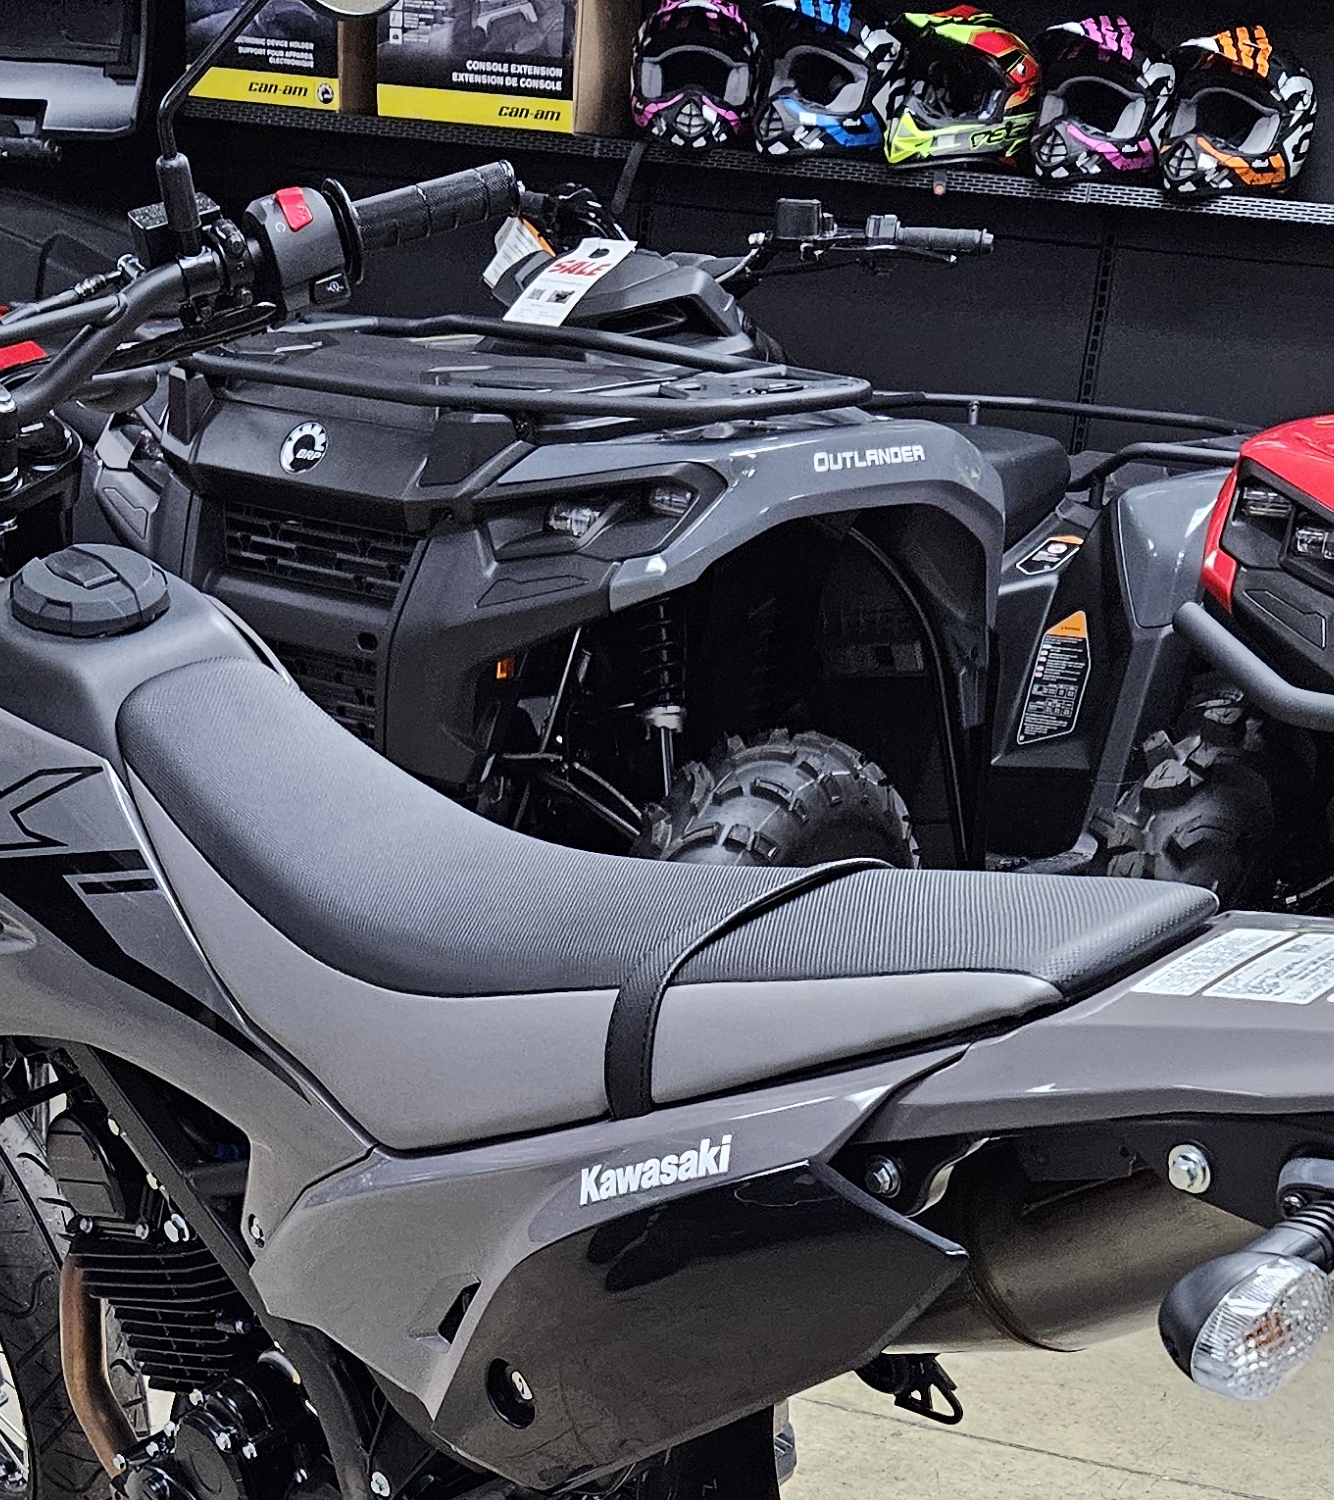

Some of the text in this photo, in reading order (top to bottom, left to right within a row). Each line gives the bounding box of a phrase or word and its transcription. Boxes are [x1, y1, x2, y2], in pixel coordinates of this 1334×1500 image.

[466, 60, 563, 78] CONSOLE EXTENSION
[248, 81, 309, 97] can-am
[452, 72, 563, 91] EXTENSION DE CONSOLE
[498, 105, 561, 121] can-am
[548, 259, 612, 277] SALE
[295, 448, 323, 461] BRP
[813, 444, 926, 473] OUTLANDER
[579, 1134, 733, 1207] Kawasaki
